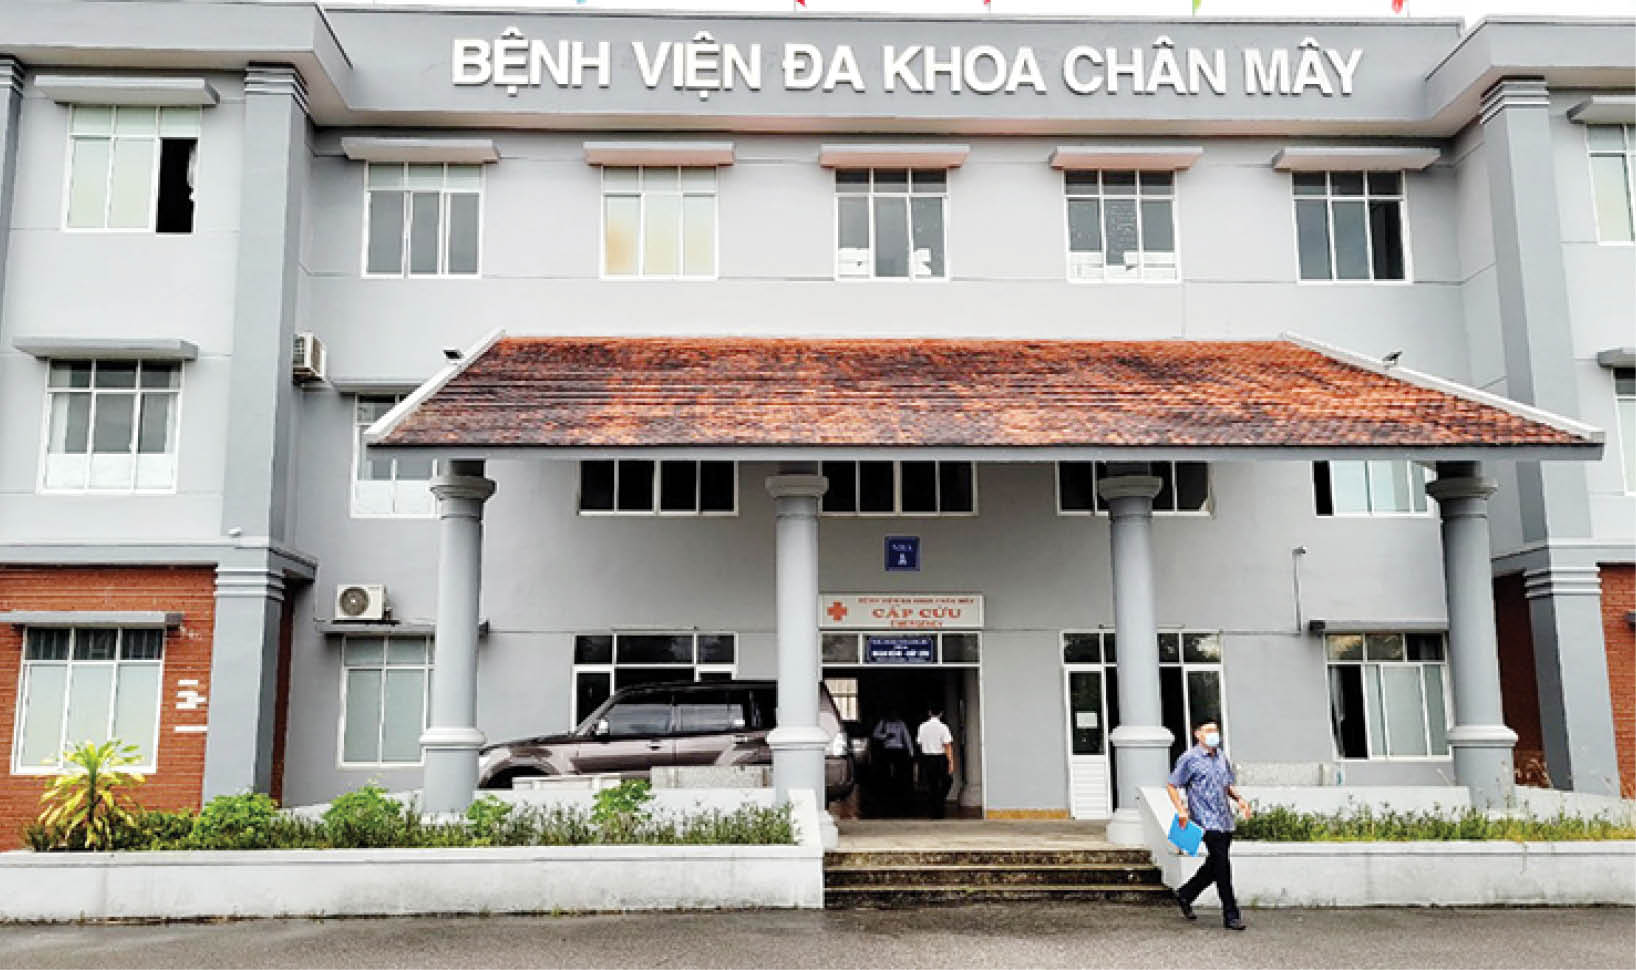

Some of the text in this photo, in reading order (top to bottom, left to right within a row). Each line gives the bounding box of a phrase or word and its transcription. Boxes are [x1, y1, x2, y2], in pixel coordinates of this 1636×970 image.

[451, 26, 1365, 101] BỆNH VIỆN ĐA KHOA CHÂN MÂY
